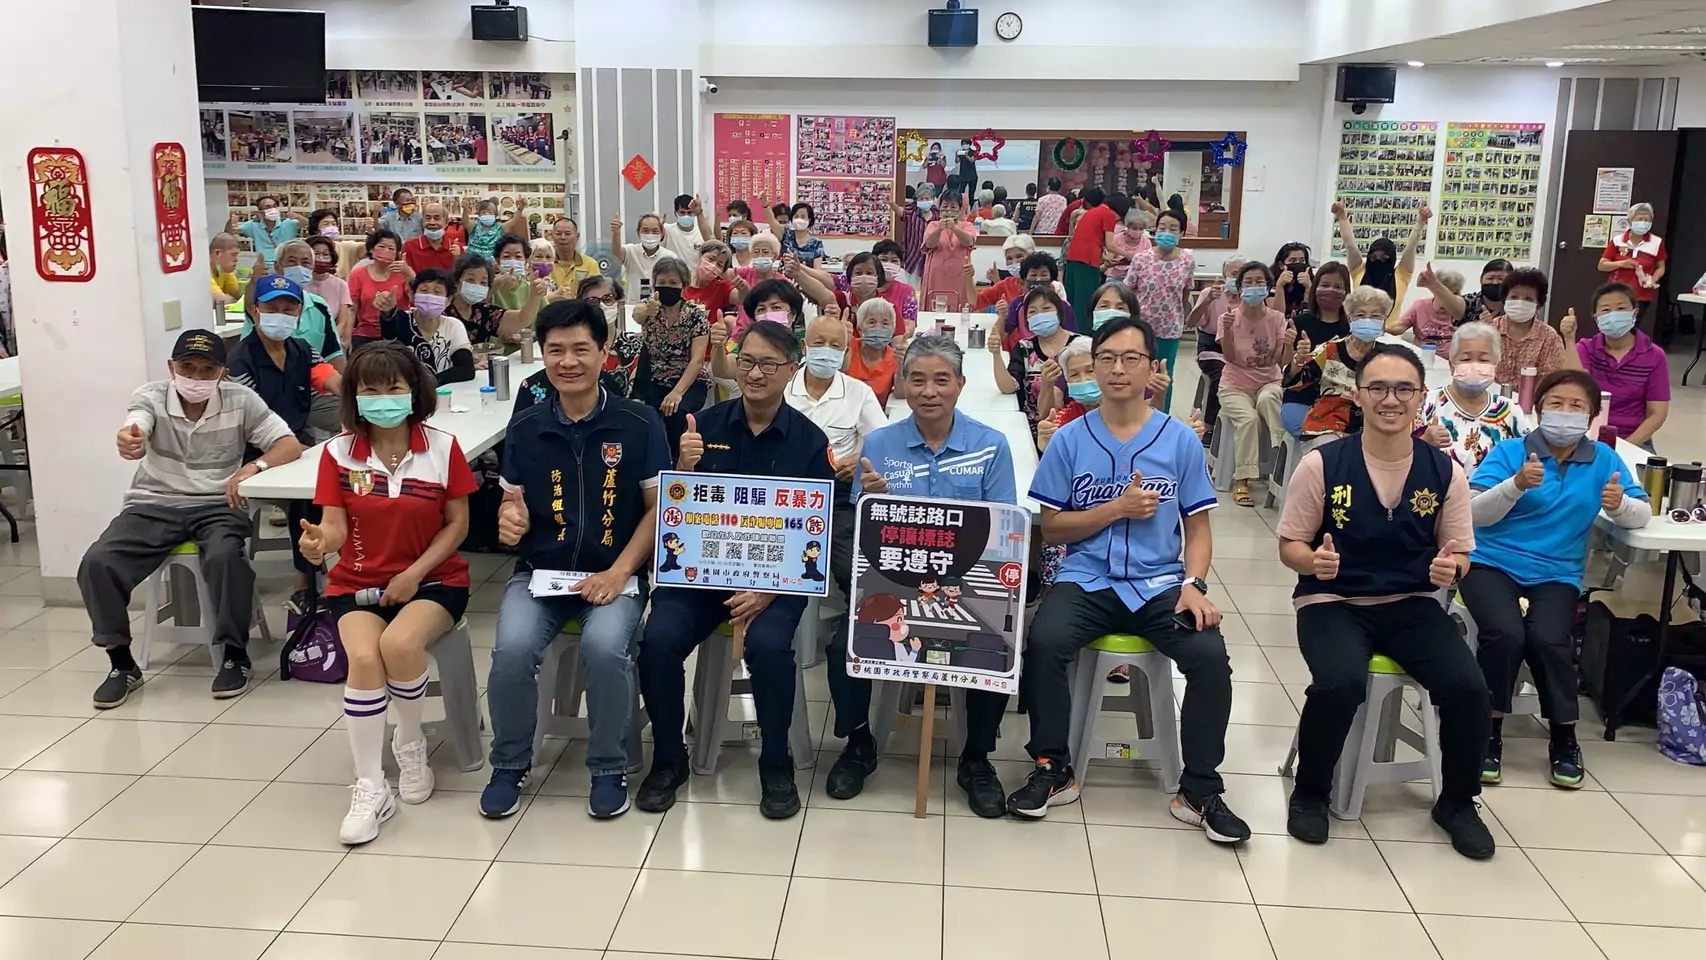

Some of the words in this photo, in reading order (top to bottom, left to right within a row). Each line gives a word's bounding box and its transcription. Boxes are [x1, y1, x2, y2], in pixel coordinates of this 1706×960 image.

[949, 467, 984, 475] CUMAR
[693, 483, 726, 504] 拒毒
[734, 486, 767, 506] 阻騙
[774, 488, 825, 510] 反暴力
[1072, 471, 1177, 507] Guarians
[601, 468, 618, 547] 蘆竹分局
[870, 502, 964, 528] 無號誌路口
[1331, 484, 1353, 530] 刑警
[880, 525, 956, 549] 停讓標誌
[879, 546, 954, 576] 要遵守
[1004, 568, 1020, 583] 停
[863, 665, 978, 685] 桃園市政府警察局蘆竹分局
